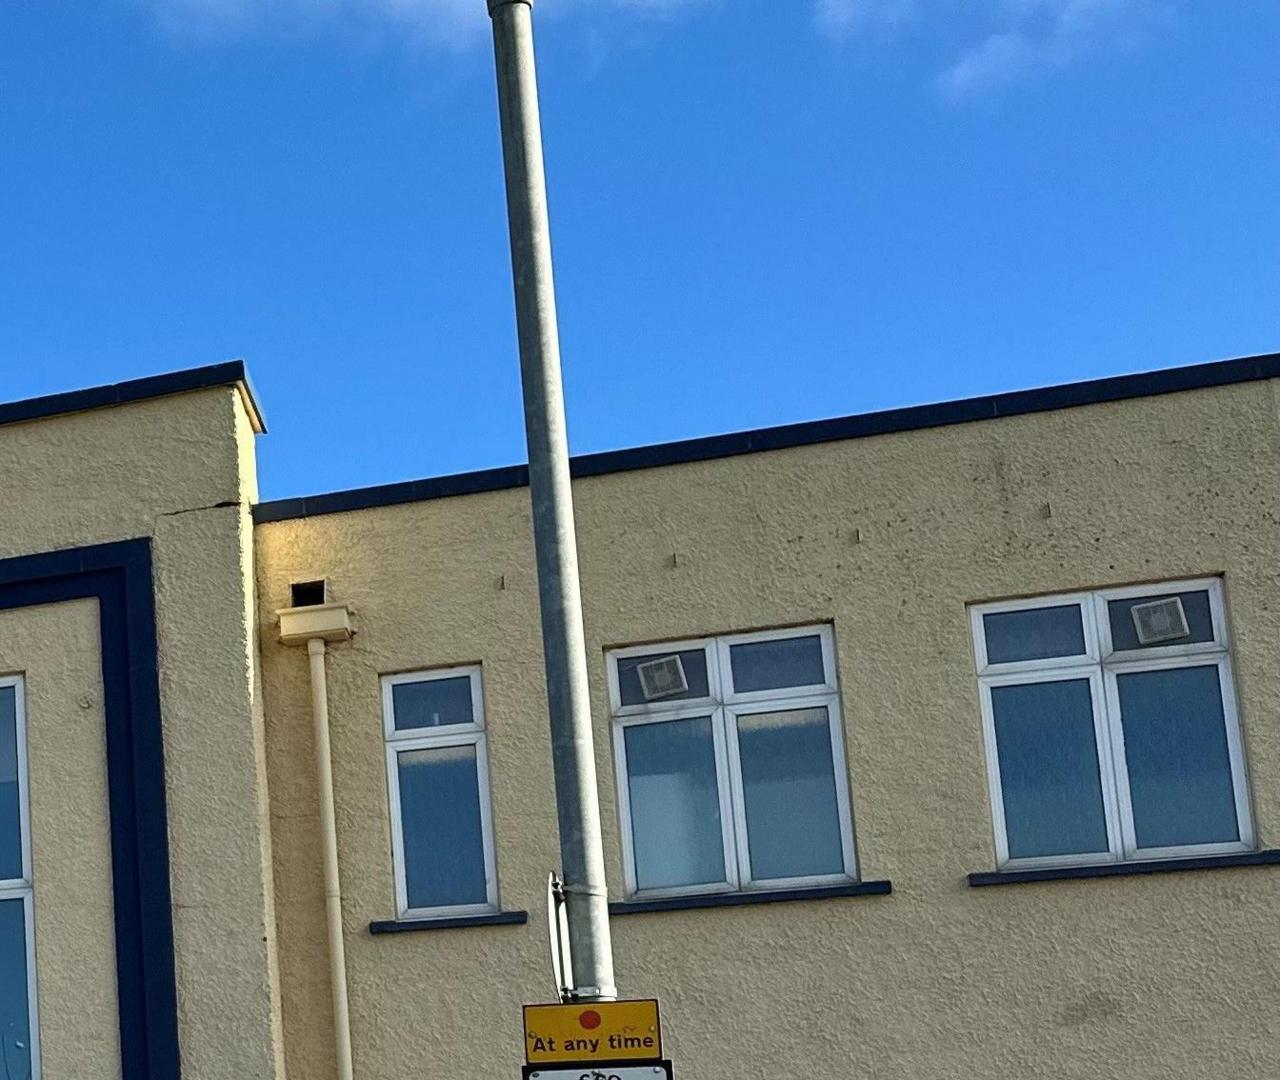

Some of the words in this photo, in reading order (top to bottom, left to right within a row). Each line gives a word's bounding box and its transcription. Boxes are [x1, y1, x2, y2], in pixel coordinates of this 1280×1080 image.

[533, 1037, 556, 1052] At
[564, 1039, 600, 1053] any
[608, 1034, 654, 1049] time
